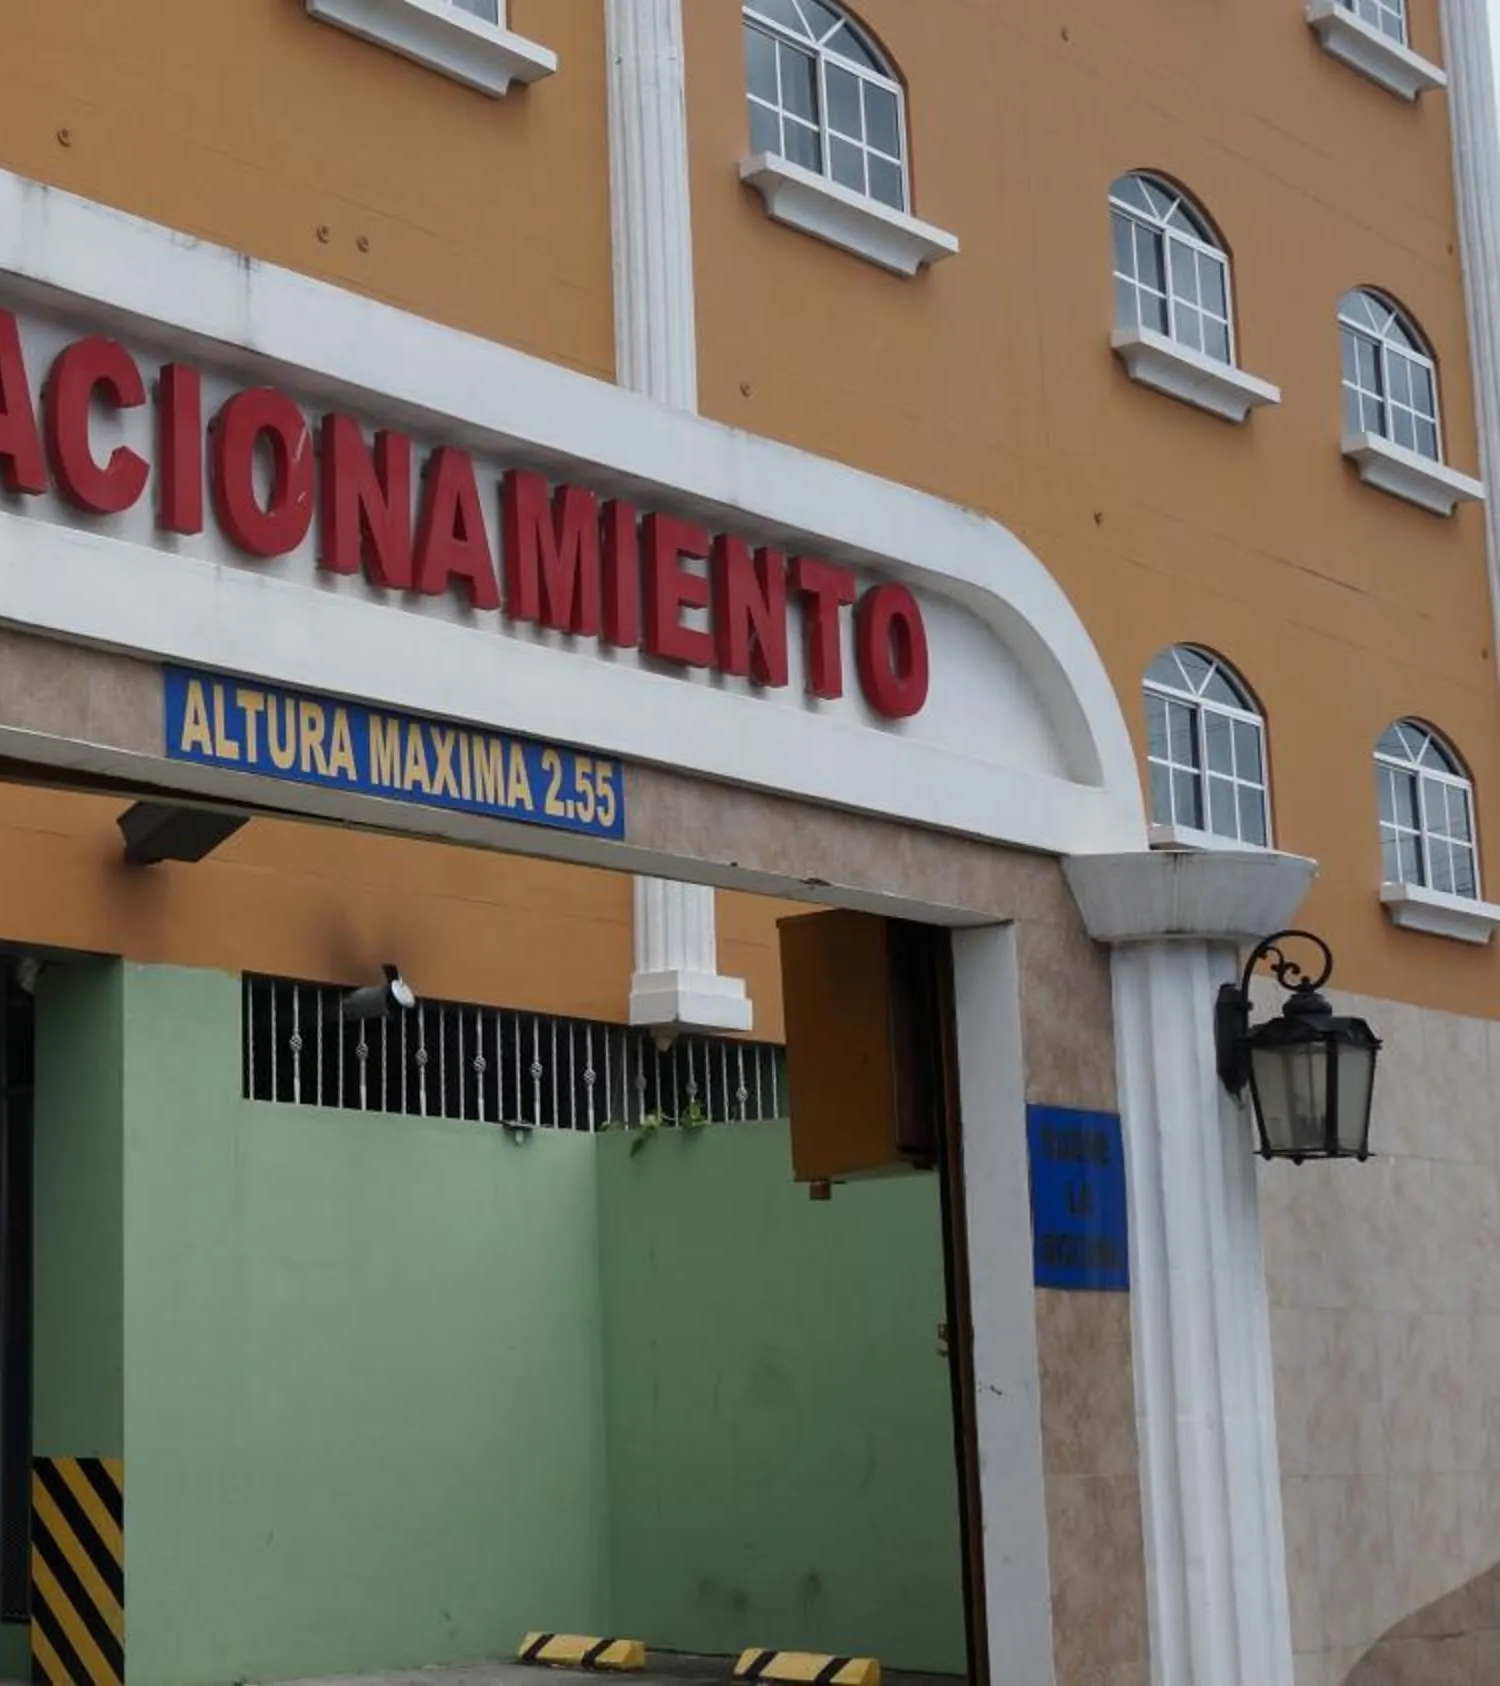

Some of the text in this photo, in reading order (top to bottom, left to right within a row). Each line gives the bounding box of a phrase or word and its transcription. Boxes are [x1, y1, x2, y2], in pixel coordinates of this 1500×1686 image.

[180, 678, 616, 828] ALTURA MAXIMA 2.55
